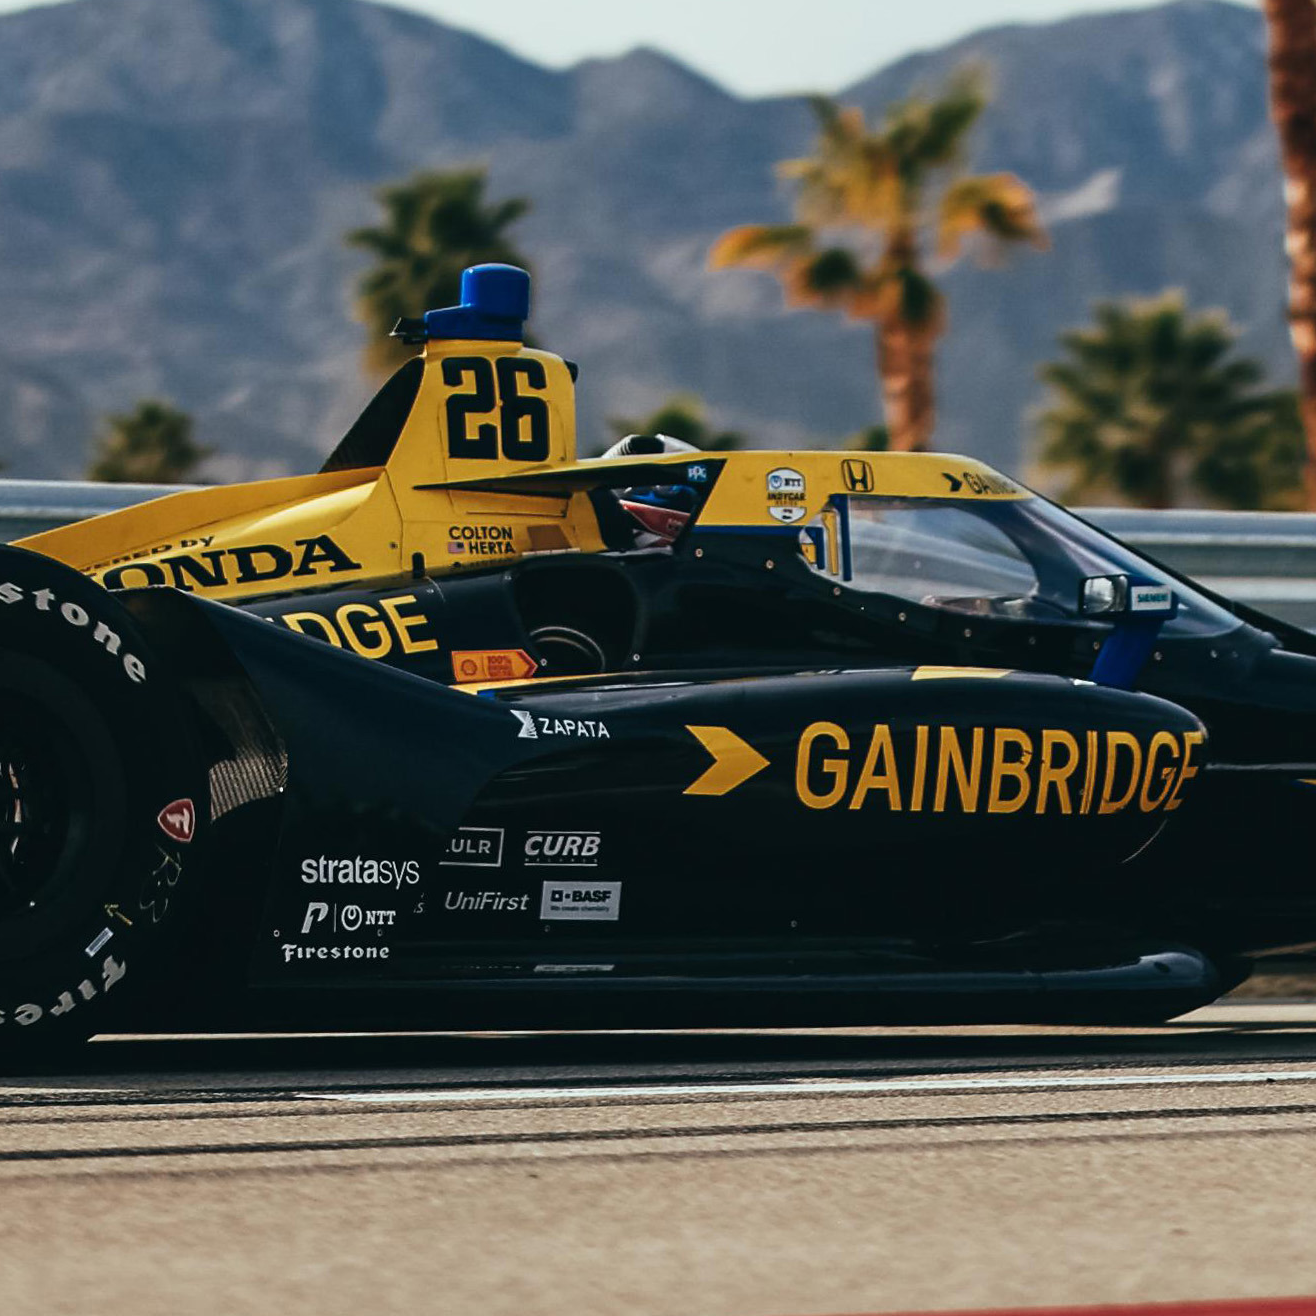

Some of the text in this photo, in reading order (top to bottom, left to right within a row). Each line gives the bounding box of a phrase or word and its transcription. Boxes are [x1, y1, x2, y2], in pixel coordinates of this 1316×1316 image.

[441, 356, 550, 462] 26
[767, 492, 806, 501] INDYCAR
[448, 525, 513, 540] COLTON
[469, 541, 516, 555] HERTA
[86, 534, 362, 592] ONDA
[265, 595, 438, 659] DGE
[538, 717, 610, 739] ZAPATA
[795, 720, 1204, 816] GAINBRIDGE
[445, 838, 492, 854] ULR
[524, 835, 601, 856] CURB
[301, 854, 420, 890] stratasys
[444, 891, 530, 911] UniFirst
[572, 890, 612, 903] BASF
[365, 910, 397, 925] NTT
[281, 943, 390, 963] Firestone
